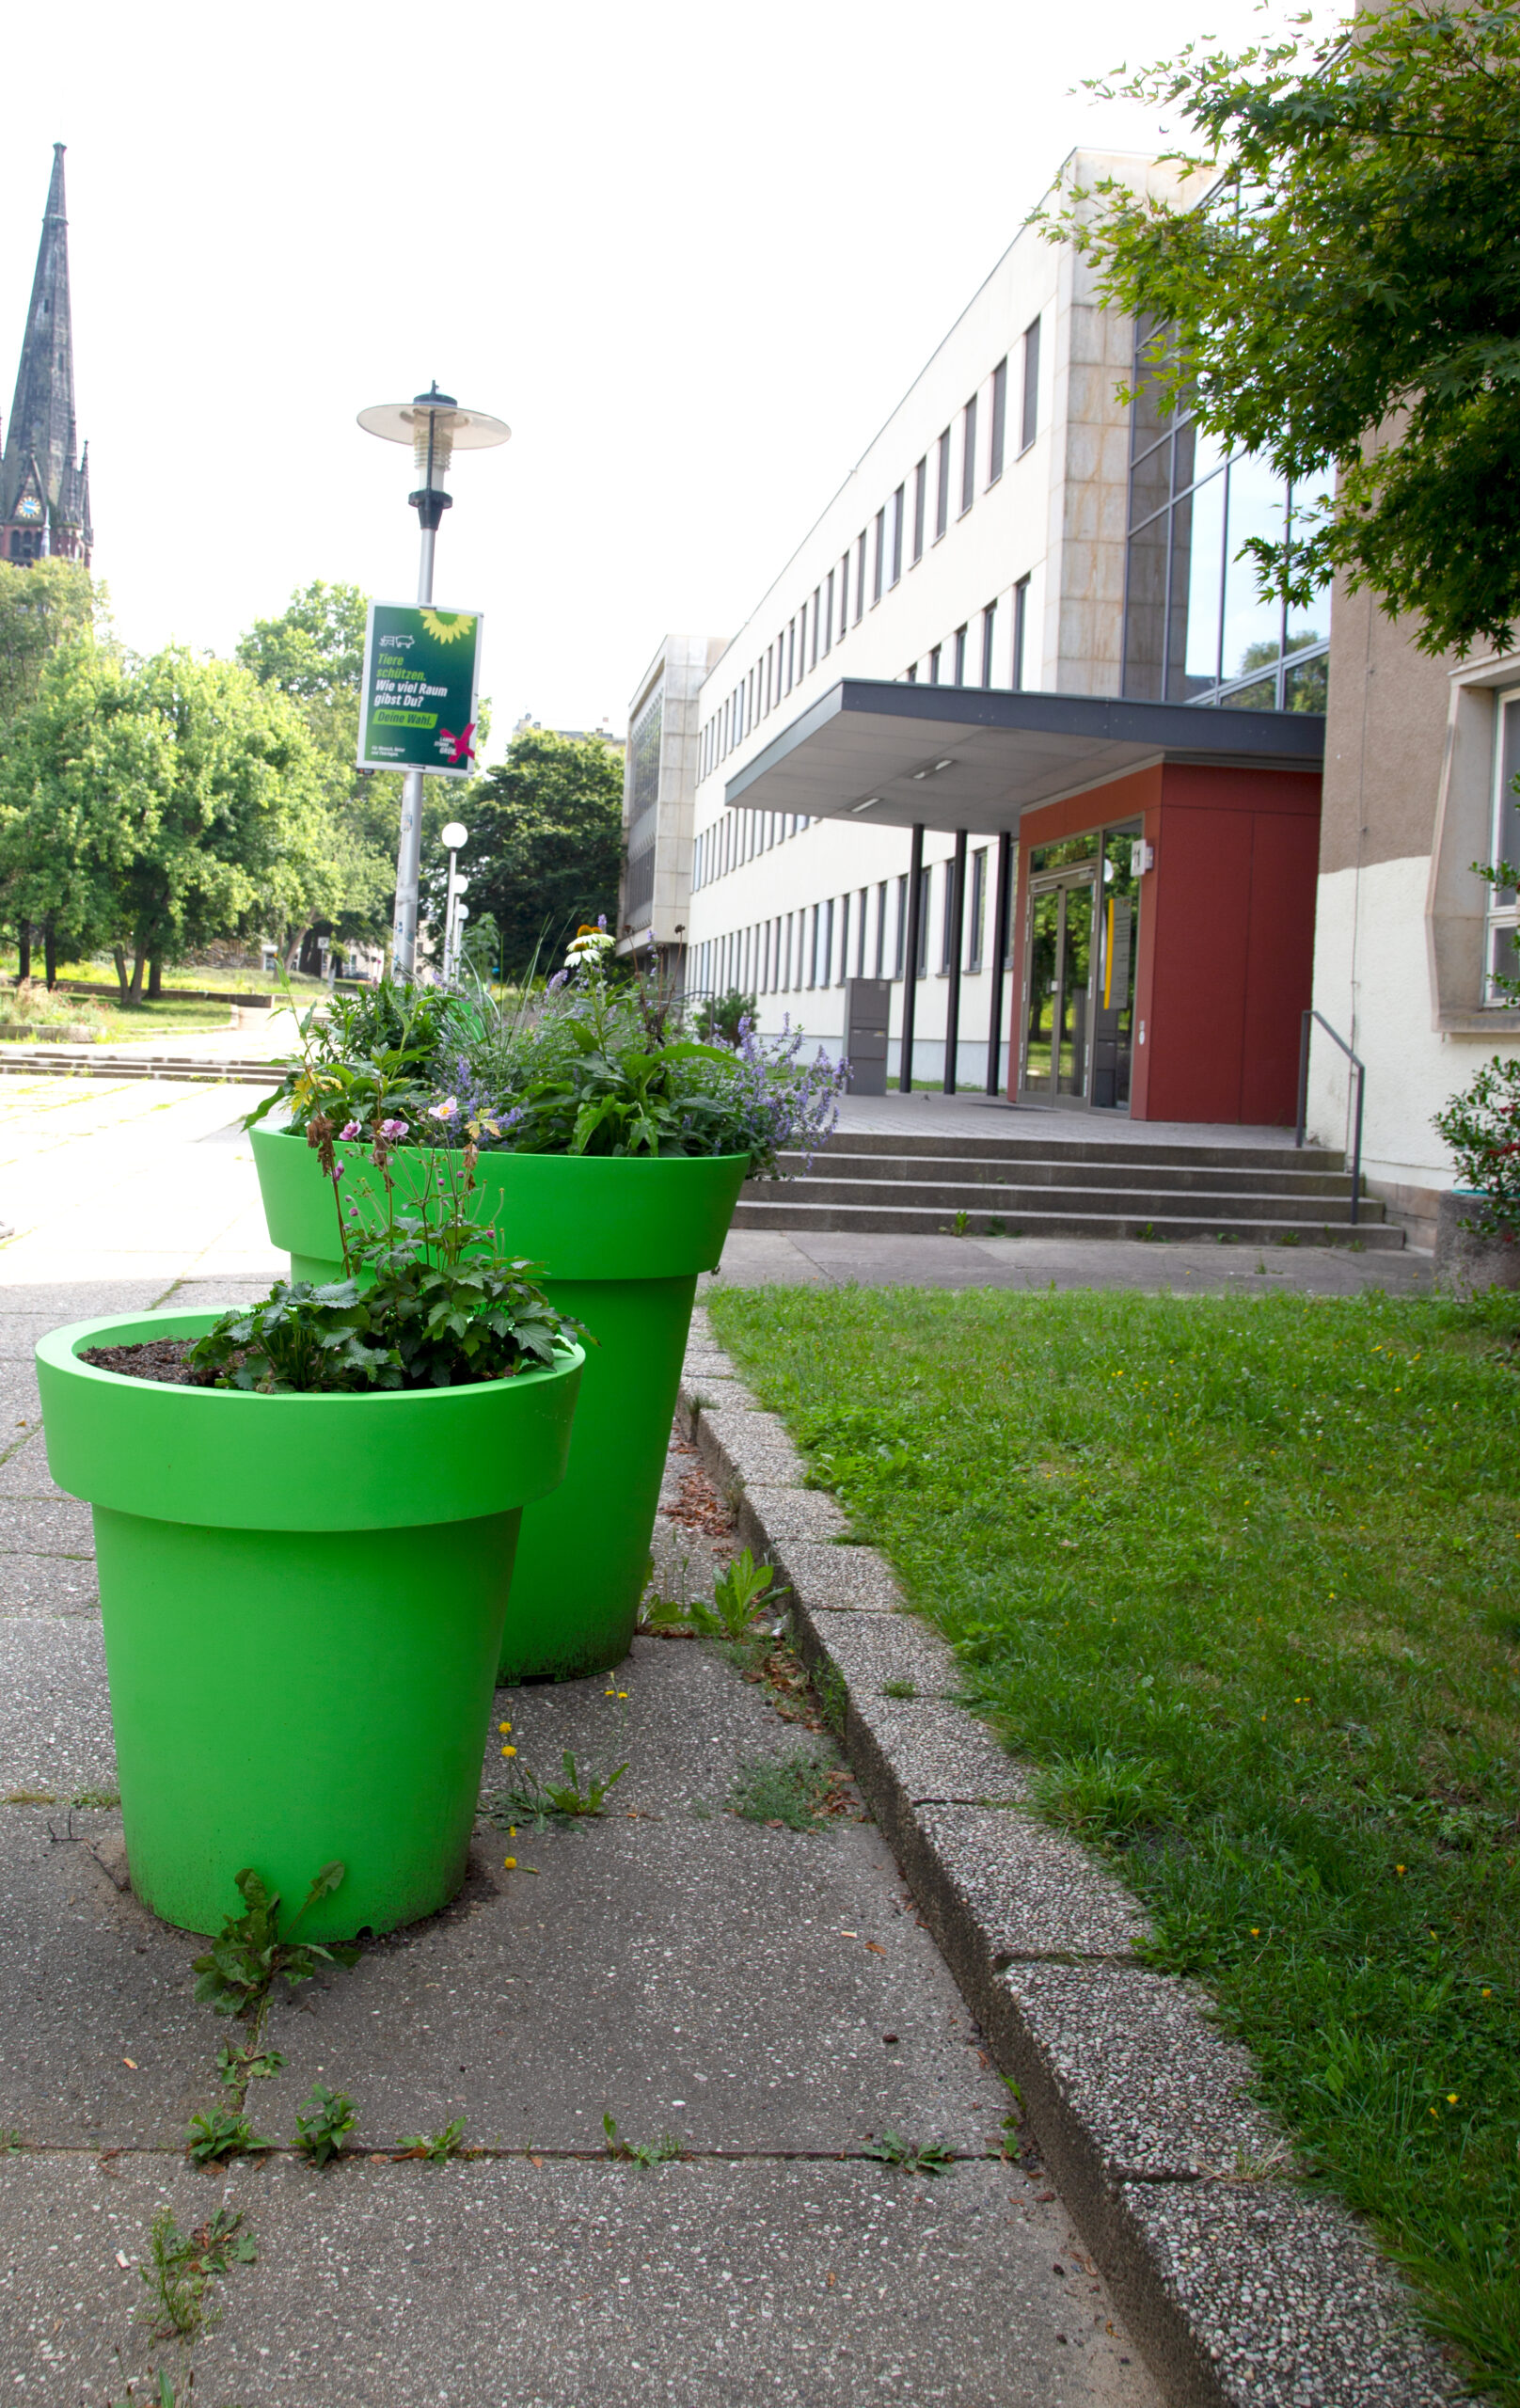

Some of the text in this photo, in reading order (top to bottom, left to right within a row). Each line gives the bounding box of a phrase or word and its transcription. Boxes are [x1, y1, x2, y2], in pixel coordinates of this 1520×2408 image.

[378, 653, 404, 666] Tiere
[376, 667, 426, 682] schützen.
[375, 679, 448, 697] Wie viel Raum
[373, 692, 424, 707] gibst Du?
[377, 711, 432, 726] Deine Wahl.
